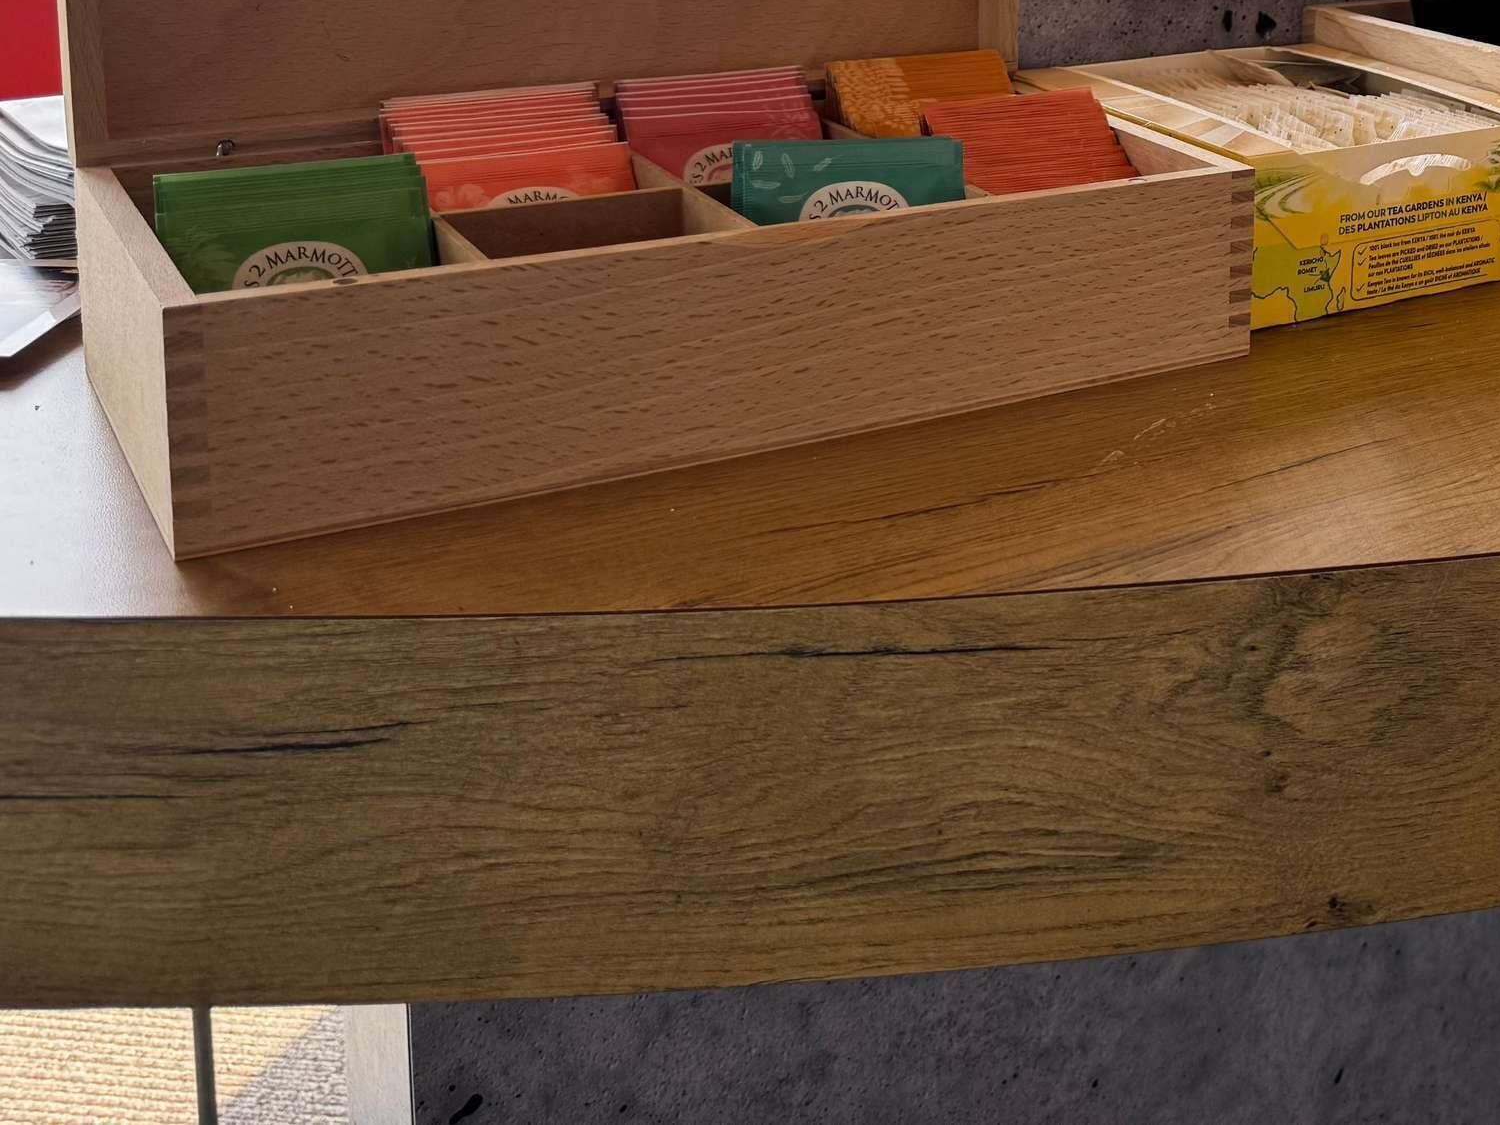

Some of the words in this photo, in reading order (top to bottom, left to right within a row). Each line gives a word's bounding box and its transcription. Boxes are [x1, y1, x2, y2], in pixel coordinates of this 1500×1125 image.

[813, 200, 828, 212] 2
[1338, 224, 1356, 236] DES
[1357, 215, 1416, 232] PLANTATIONS
[1417, 211, 1448, 223] LIPTON
[1448, 207, 1460, 217] AU
[1461, 203, 1489, 216] KENYA
[1340, 211, 1366, 223] FROM
[1366, 208, 1386, 219] OUR
[1387, 204, 1404, 216] TEA
[1405, 198, 1445, 213] GARDENS
[1445, 196, 1455, 206] IN
[1455, 193, 1483, 205] KENYA
[248, 264, 266, 278] 2
[265, 246, 358, 277] MARMOTT
